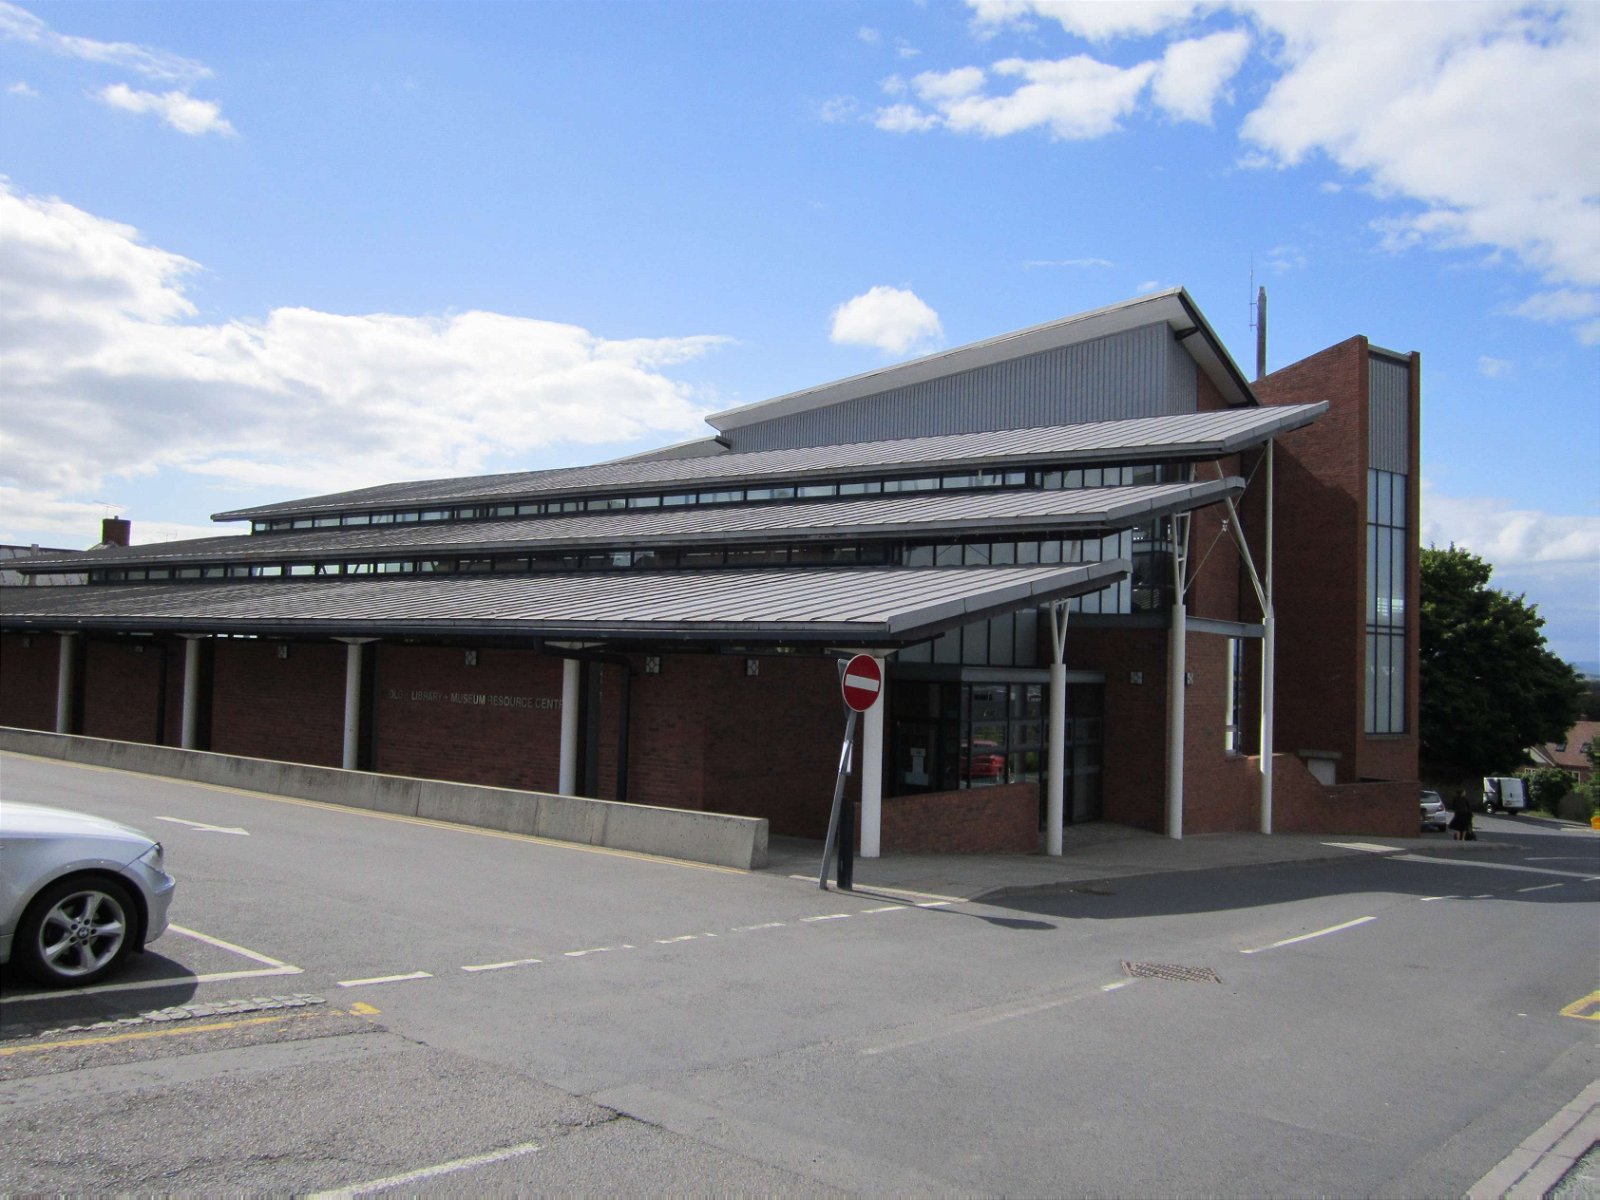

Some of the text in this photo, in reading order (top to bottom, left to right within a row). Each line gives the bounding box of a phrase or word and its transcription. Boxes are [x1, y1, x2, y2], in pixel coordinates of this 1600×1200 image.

[411, 689, 442, 703] LIBRARY
[449, 691, 486, 705] MUSEUM
[487, 694, 533, 709] RESOURCE
[535, 697, 562, 710] CENTR
